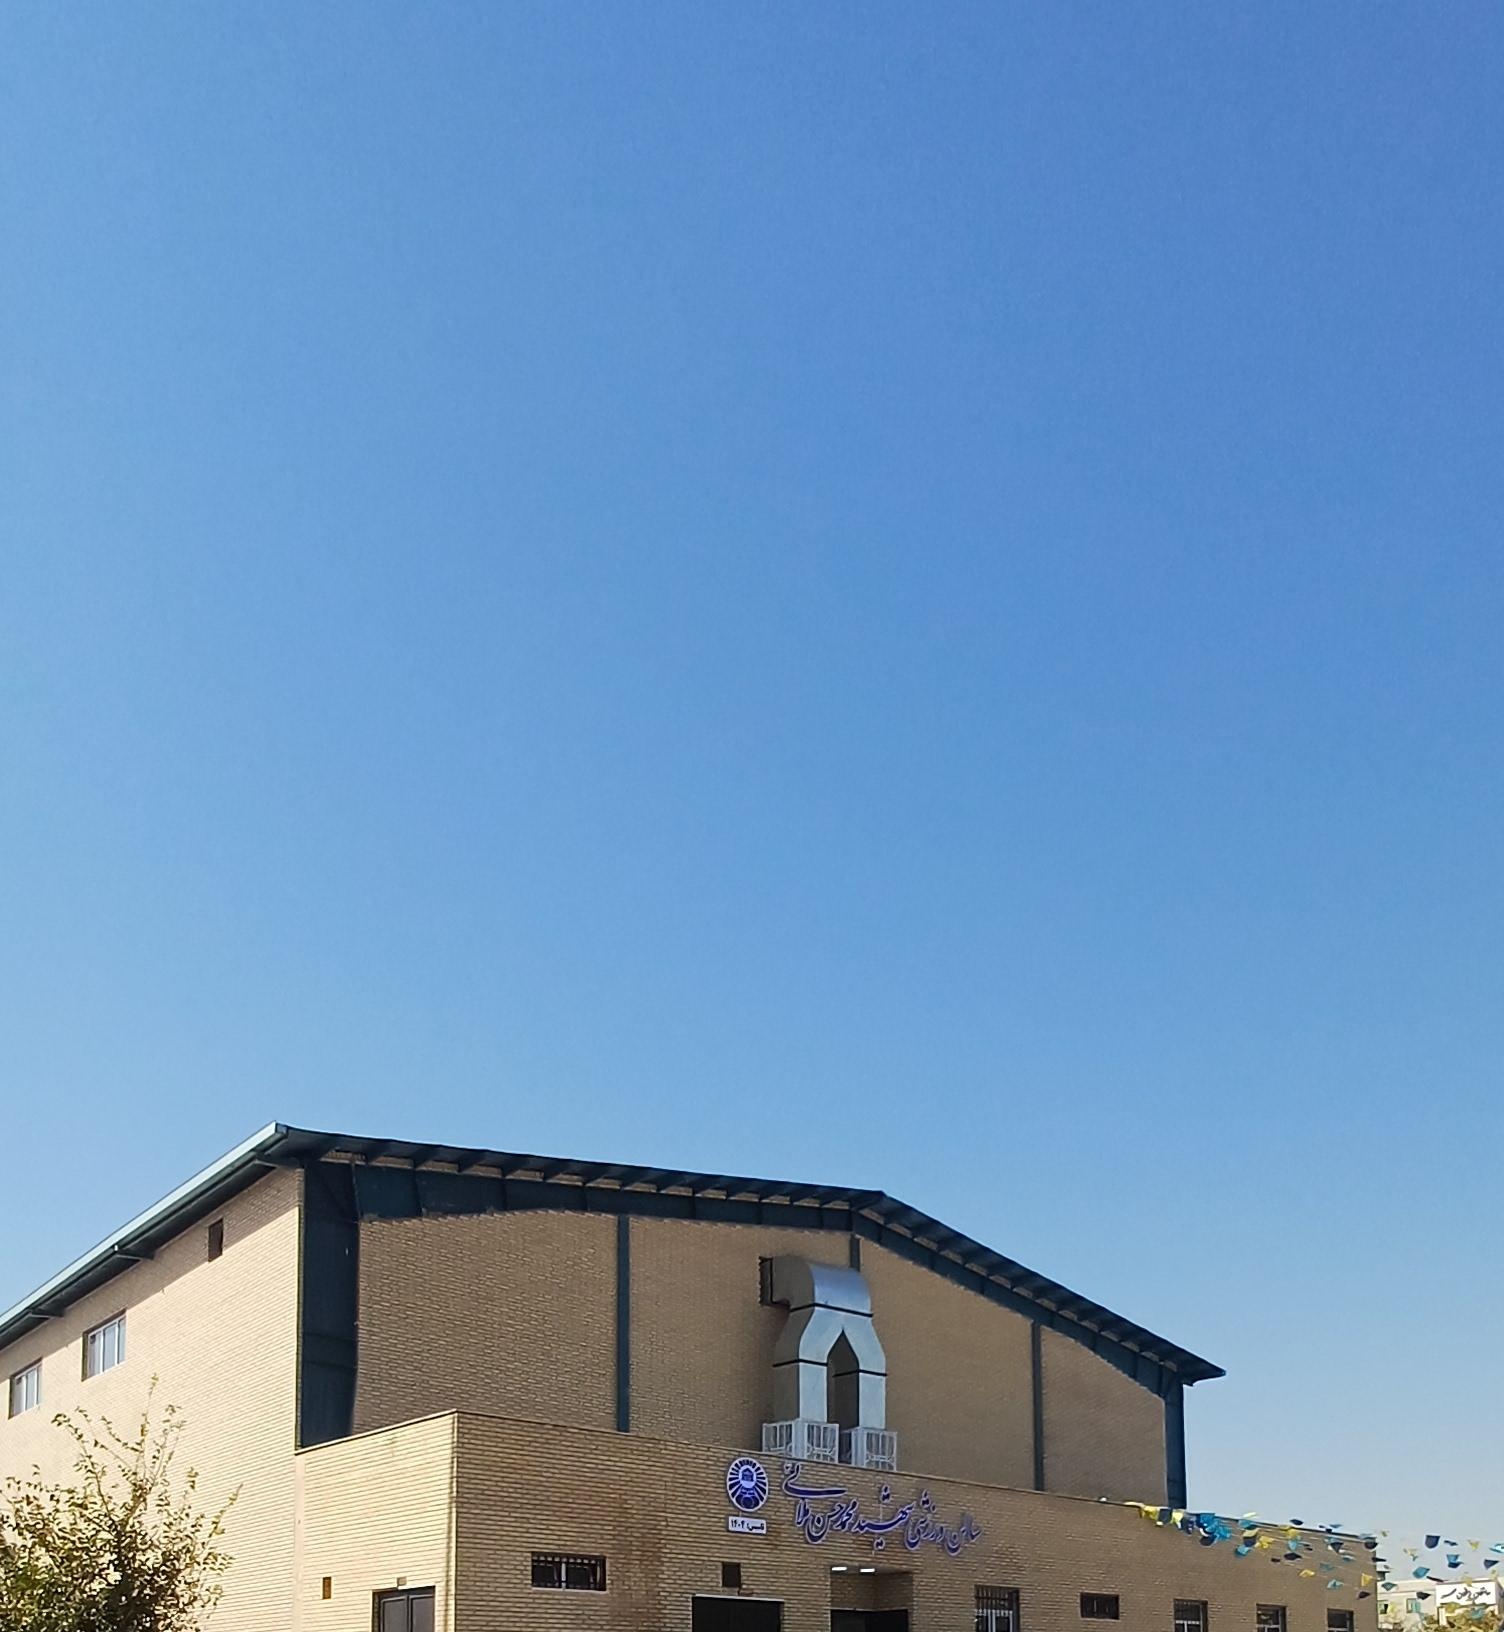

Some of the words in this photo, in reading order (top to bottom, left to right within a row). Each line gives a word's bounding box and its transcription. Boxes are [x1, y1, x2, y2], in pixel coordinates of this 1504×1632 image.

[852, 1484, 917, 1551] شهید
[904, 1489, 946, 1551] ورزشی
[945, 1512, 982, 1556] سالن
